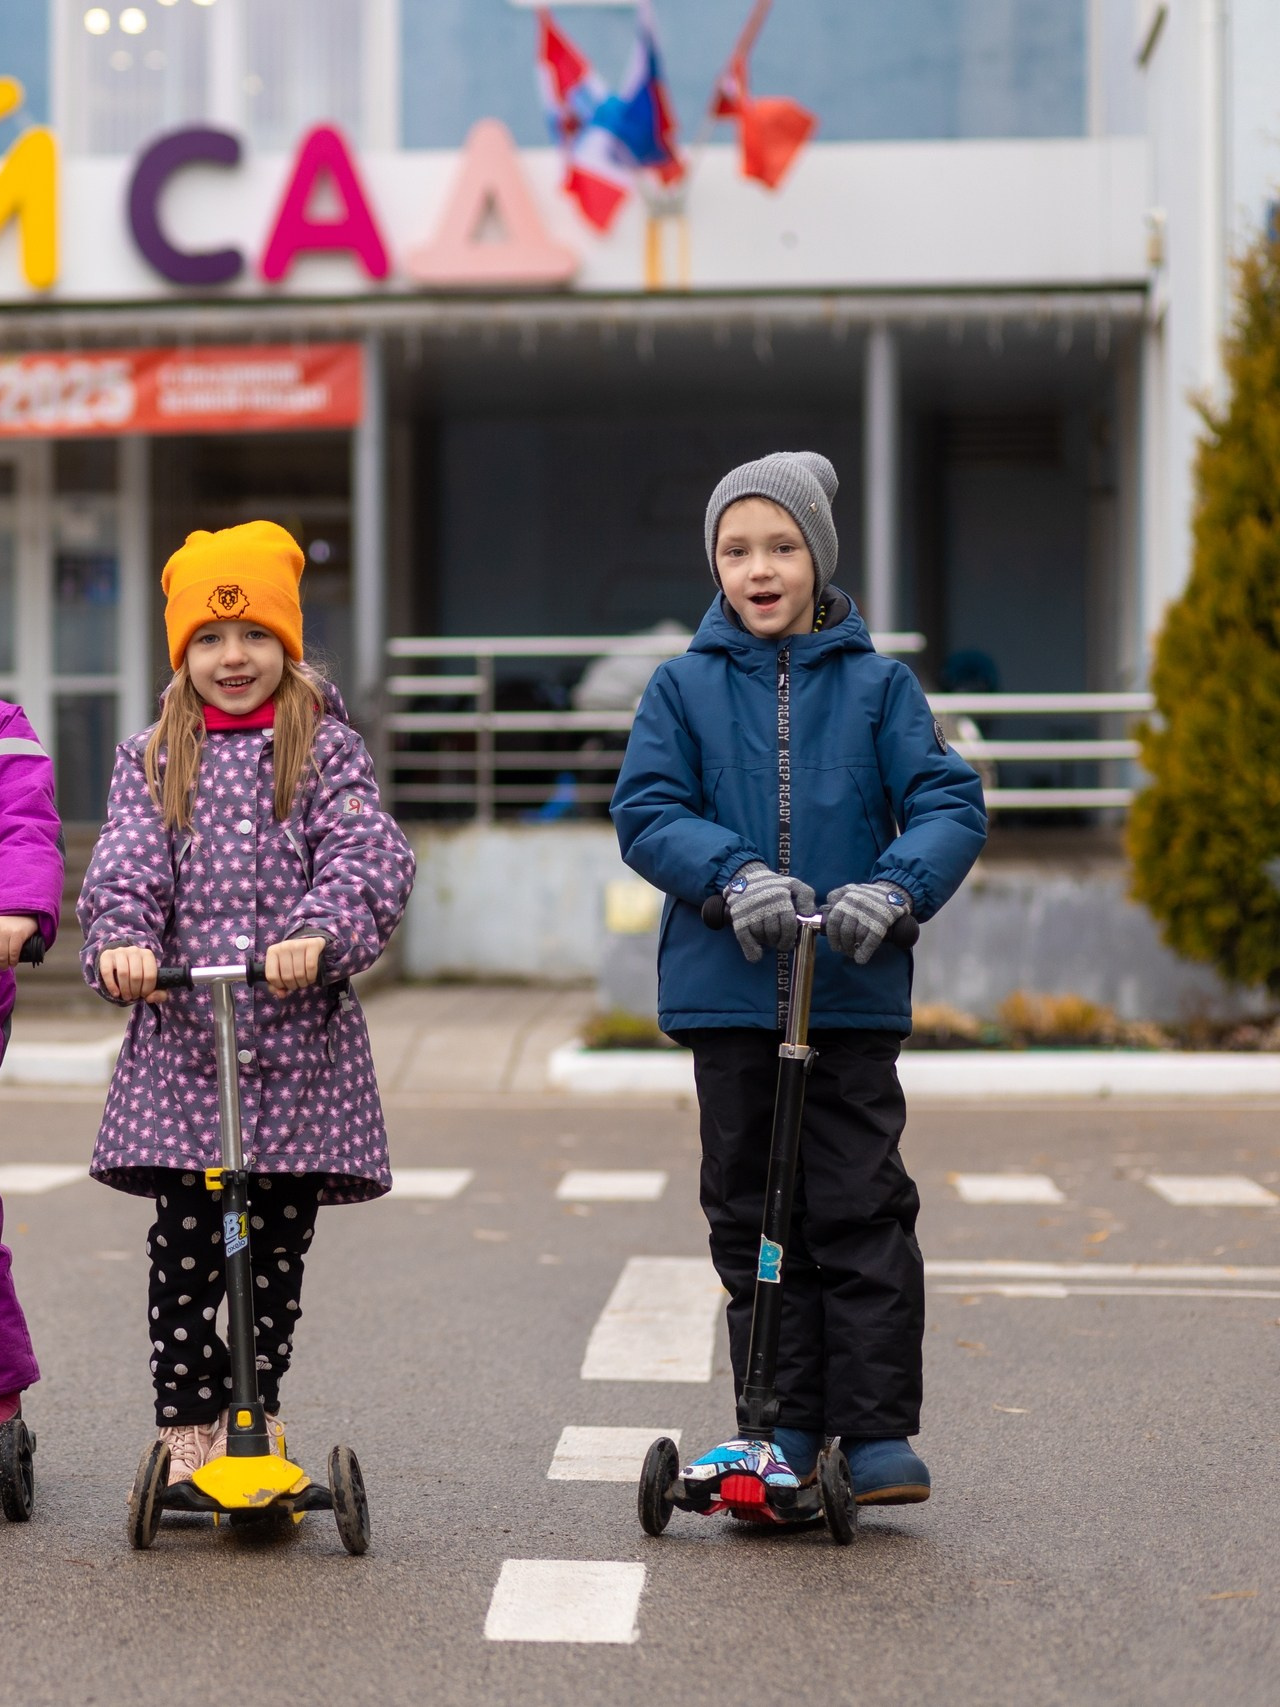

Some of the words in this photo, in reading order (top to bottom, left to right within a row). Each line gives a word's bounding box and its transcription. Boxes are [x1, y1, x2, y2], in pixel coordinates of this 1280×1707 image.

[127, 117, 578, 288] САД
[777, 704, 790, 742] READY
[778, 749, 791, 781] KEEP
[778, 784, 791, 824] READY
[778, 832, 791, 865] KEEP
[776, 952, 790, 992] READY
[223, 1211, 248, 1241] B1
[227, 1239, 246, 1253] oxelo
